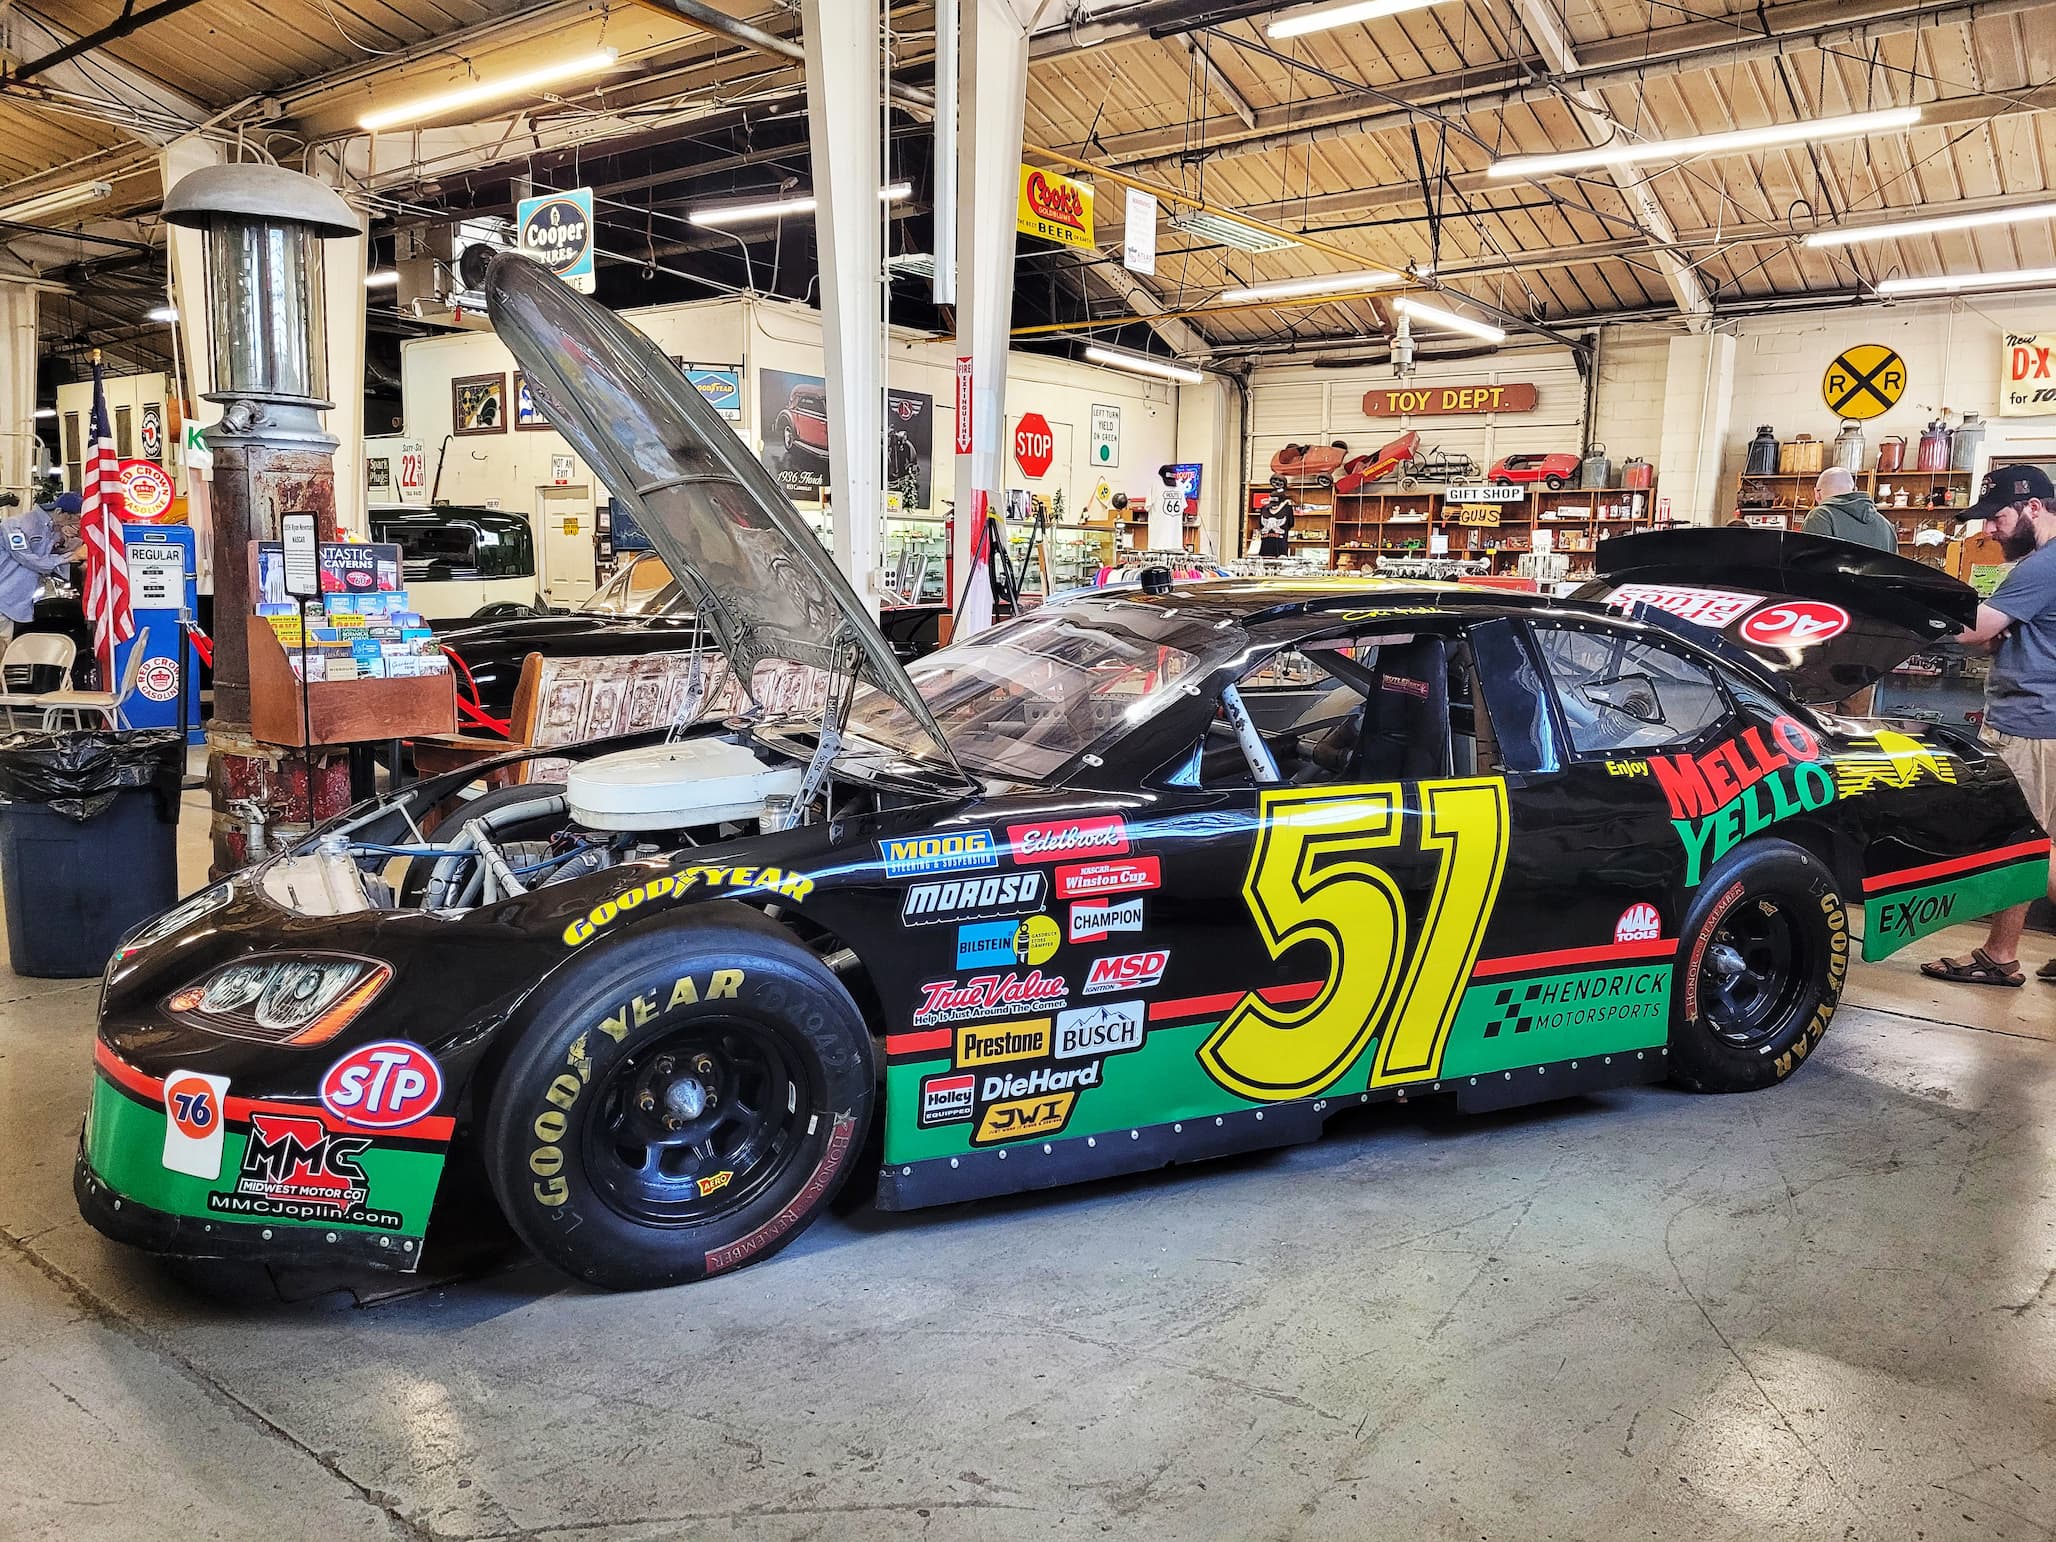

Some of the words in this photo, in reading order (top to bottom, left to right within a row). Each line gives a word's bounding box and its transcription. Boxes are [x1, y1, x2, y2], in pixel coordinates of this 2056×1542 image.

[1027, 171, 1084, 219] Cook's
[527, 222, 584, 247] Cooper
[1038, 222, 1073, 241] BEER
[540, 247, 579, 265] TIRES
[2006, 334, 2037, 347] New
[958, 365, 971, 374] FIRE
[2012, 347, 2051, 380] D-X
[697, 382, 733, 393] OODYEAR
[1830, 376, 1845, 394] R
[1885, 372, 1901, 390] R
[1386, 391, 1432, 412] TOY
[2009, 392, 2028, 405] for
[1094, 409, 1104, 417] LEFT
[1099, 421, 1113, 431] YIELD
[1017, 432, 1051, 458] STOP
[402, 455, 416, 487] 22
[417, 454, 422, 470] 9
[553, 458, 564, 468] NOT
[565, 460, 573, 469] AN
[556, 469, 568, 478] EXIT
[121, 472, 132, 485] ED
[136, 466, 169, 497] CROWN
[777, 470, 798, 483] 1936
[1450, 489, 1478, 499] GIFT
[1483, 488, 1520, 499] SHOP
[1166, 501, 1180, 513] 66
[1461, 509, 1501, 523] GUYS
[132, 549, 179, 561] REGULAR
[319, 548, 373, 560] NTASTIC
[324, 560, 374, 569] CAVERNS
[1618, 592, 1742, 612] PLUGS
[1752, 610, 1839, 637] AC
[138, 661, 151, 683] RED
[1605, 759, 1649, 778] Enjoy
[1647, 716, 1819, 820] MELLO
[1671, 762, 1835, 888] YELLO
[890, 834, 986, 860] MOOG
[1022, 825, 1120, 856] Edelbrock
[891, 861, 931, 873] STEERING
[933, 860, 939, 869] &
[942, 855, 991, 868] SUSPENSION
[1081, 866, 1110, 875] NASCAR
[1065, 875, 1119, 889] Winston
[1120, 871, 1147, 884] Cup
[905, 874, 1042, 916] MOROSO
[562, 866, 815, 947] GOODYEAR
[1878, 893, 1957, 937] EXXON
[1074, 908, 1141, 930] CHAMPION
[1617, 905, 1659, 933] MAC
[960, 938, 1011, 954] BILSTEIN
[1616, 930, 1659, 942] TOOLS
[1686, 960, 1699, 1006] HONOR
[1699, 886, 1743, 942] REMEMBER
[1091, 952, 1165, 980] MSD
[1084, 984, 1114, 993] IGNITION
[1541, 972, 1668, 1005] HENDRICK
[915, 1014, 936, 1026] Help
[940, 1013, 948, 1021] Is
[950, 1011, 970, 1020] Just
[973, 1006, 1009, 1017] Around
[1011, 1004, 1029, 1013] The
[1032, 999, 1066, 1010] Corner.
[1535, 1002, 1661, 1031] MOTORSPORTS
[964, 1031, 1043, 1060] Prestone
[1063, 1021, 1136, 1052] BUSCH
[332, 1052, 426, 1113] STP
[981, 1061, 1099, 1101] DieHard
[928, 1089, 972, 1106] Holley
[174, 1094, 212, 1127] 76
[926, 1108, 971, 1119] EQUIPPED
[988, 1100, 1065, 1129] JWI
[243, 1127, 373, 1185] MMC
[819, 1135, 849, 1192] HONOR
[243, 1181, 297, 1195] MIDWEST
[299, 1185, 341, 1199] MOTOR
[344, 1190, 362, 1200] CO
[703, 1174, 728, 1191] AERO
[211, 1195, 399, 1226] MMCJoplin.com
[711, 1209, 800, 1268] REMEMBER
